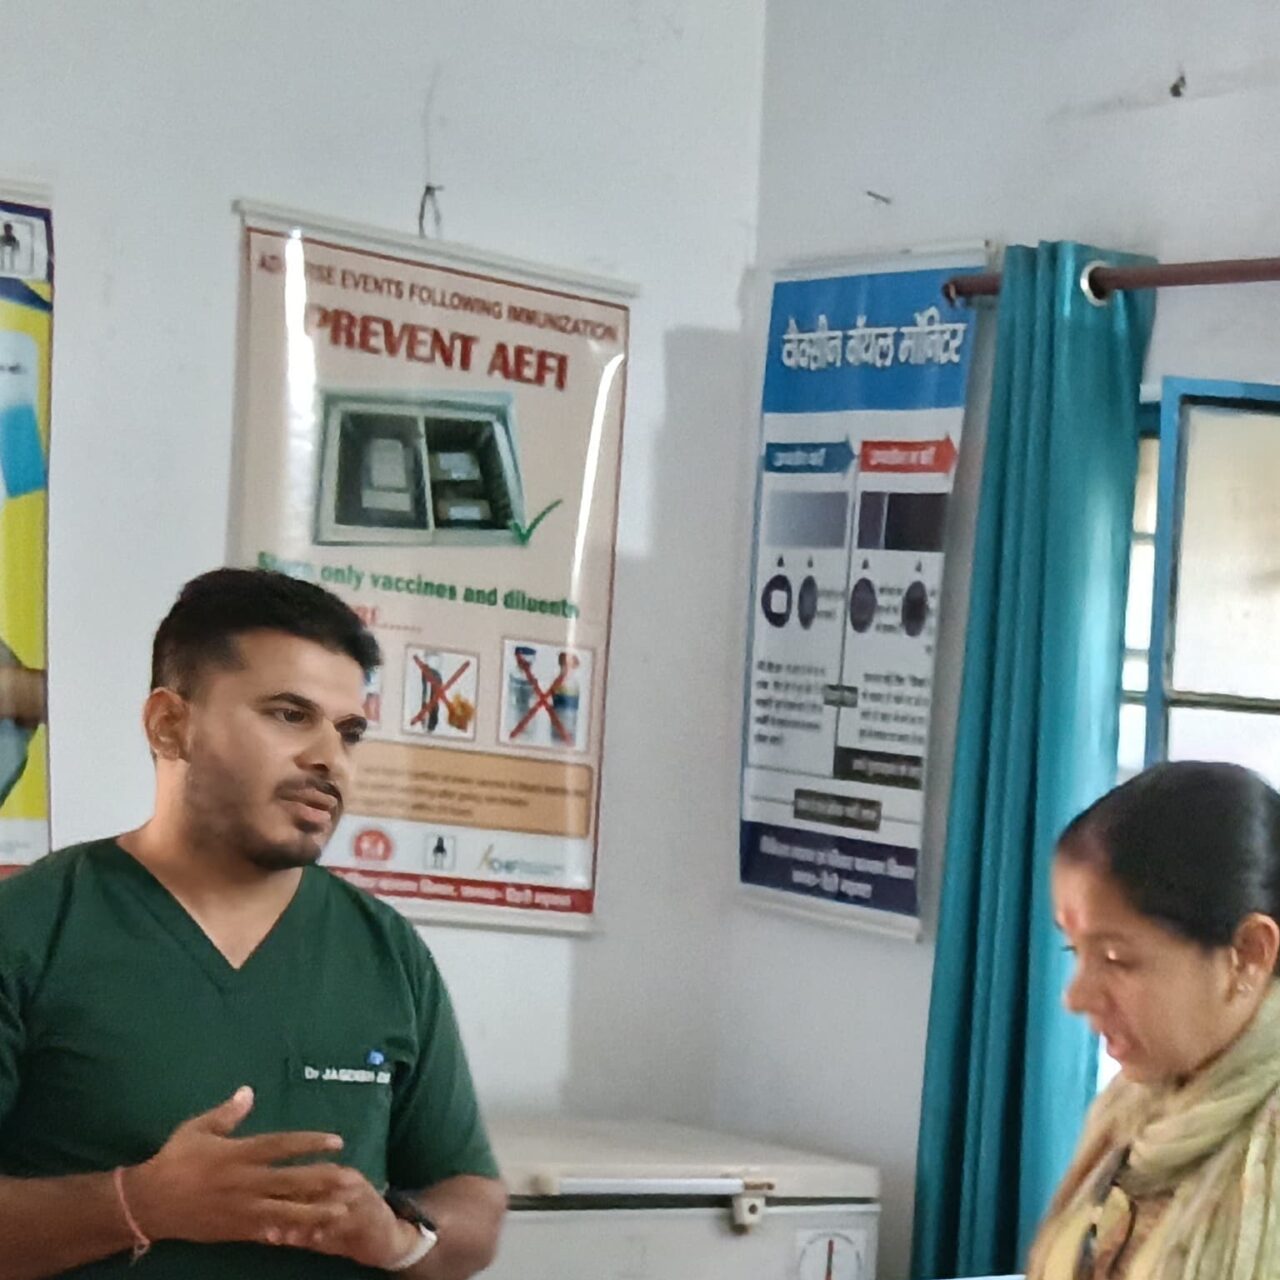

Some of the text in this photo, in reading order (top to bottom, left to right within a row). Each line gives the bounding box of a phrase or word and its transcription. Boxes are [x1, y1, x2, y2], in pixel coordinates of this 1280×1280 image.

[340, 268, 404, 300] EVENTS
[408, 282, 504, 320] FOLLOWING
[507, 304, 619, 343] IMMUNIZATION
[487, 341, 569, 391] AEFI
[320, 564, 365, 591] only
[371, 572, 457, 601] vaccines
[463, 586, 498, 606] and
[304, 1066, 319, 1080] Dr
